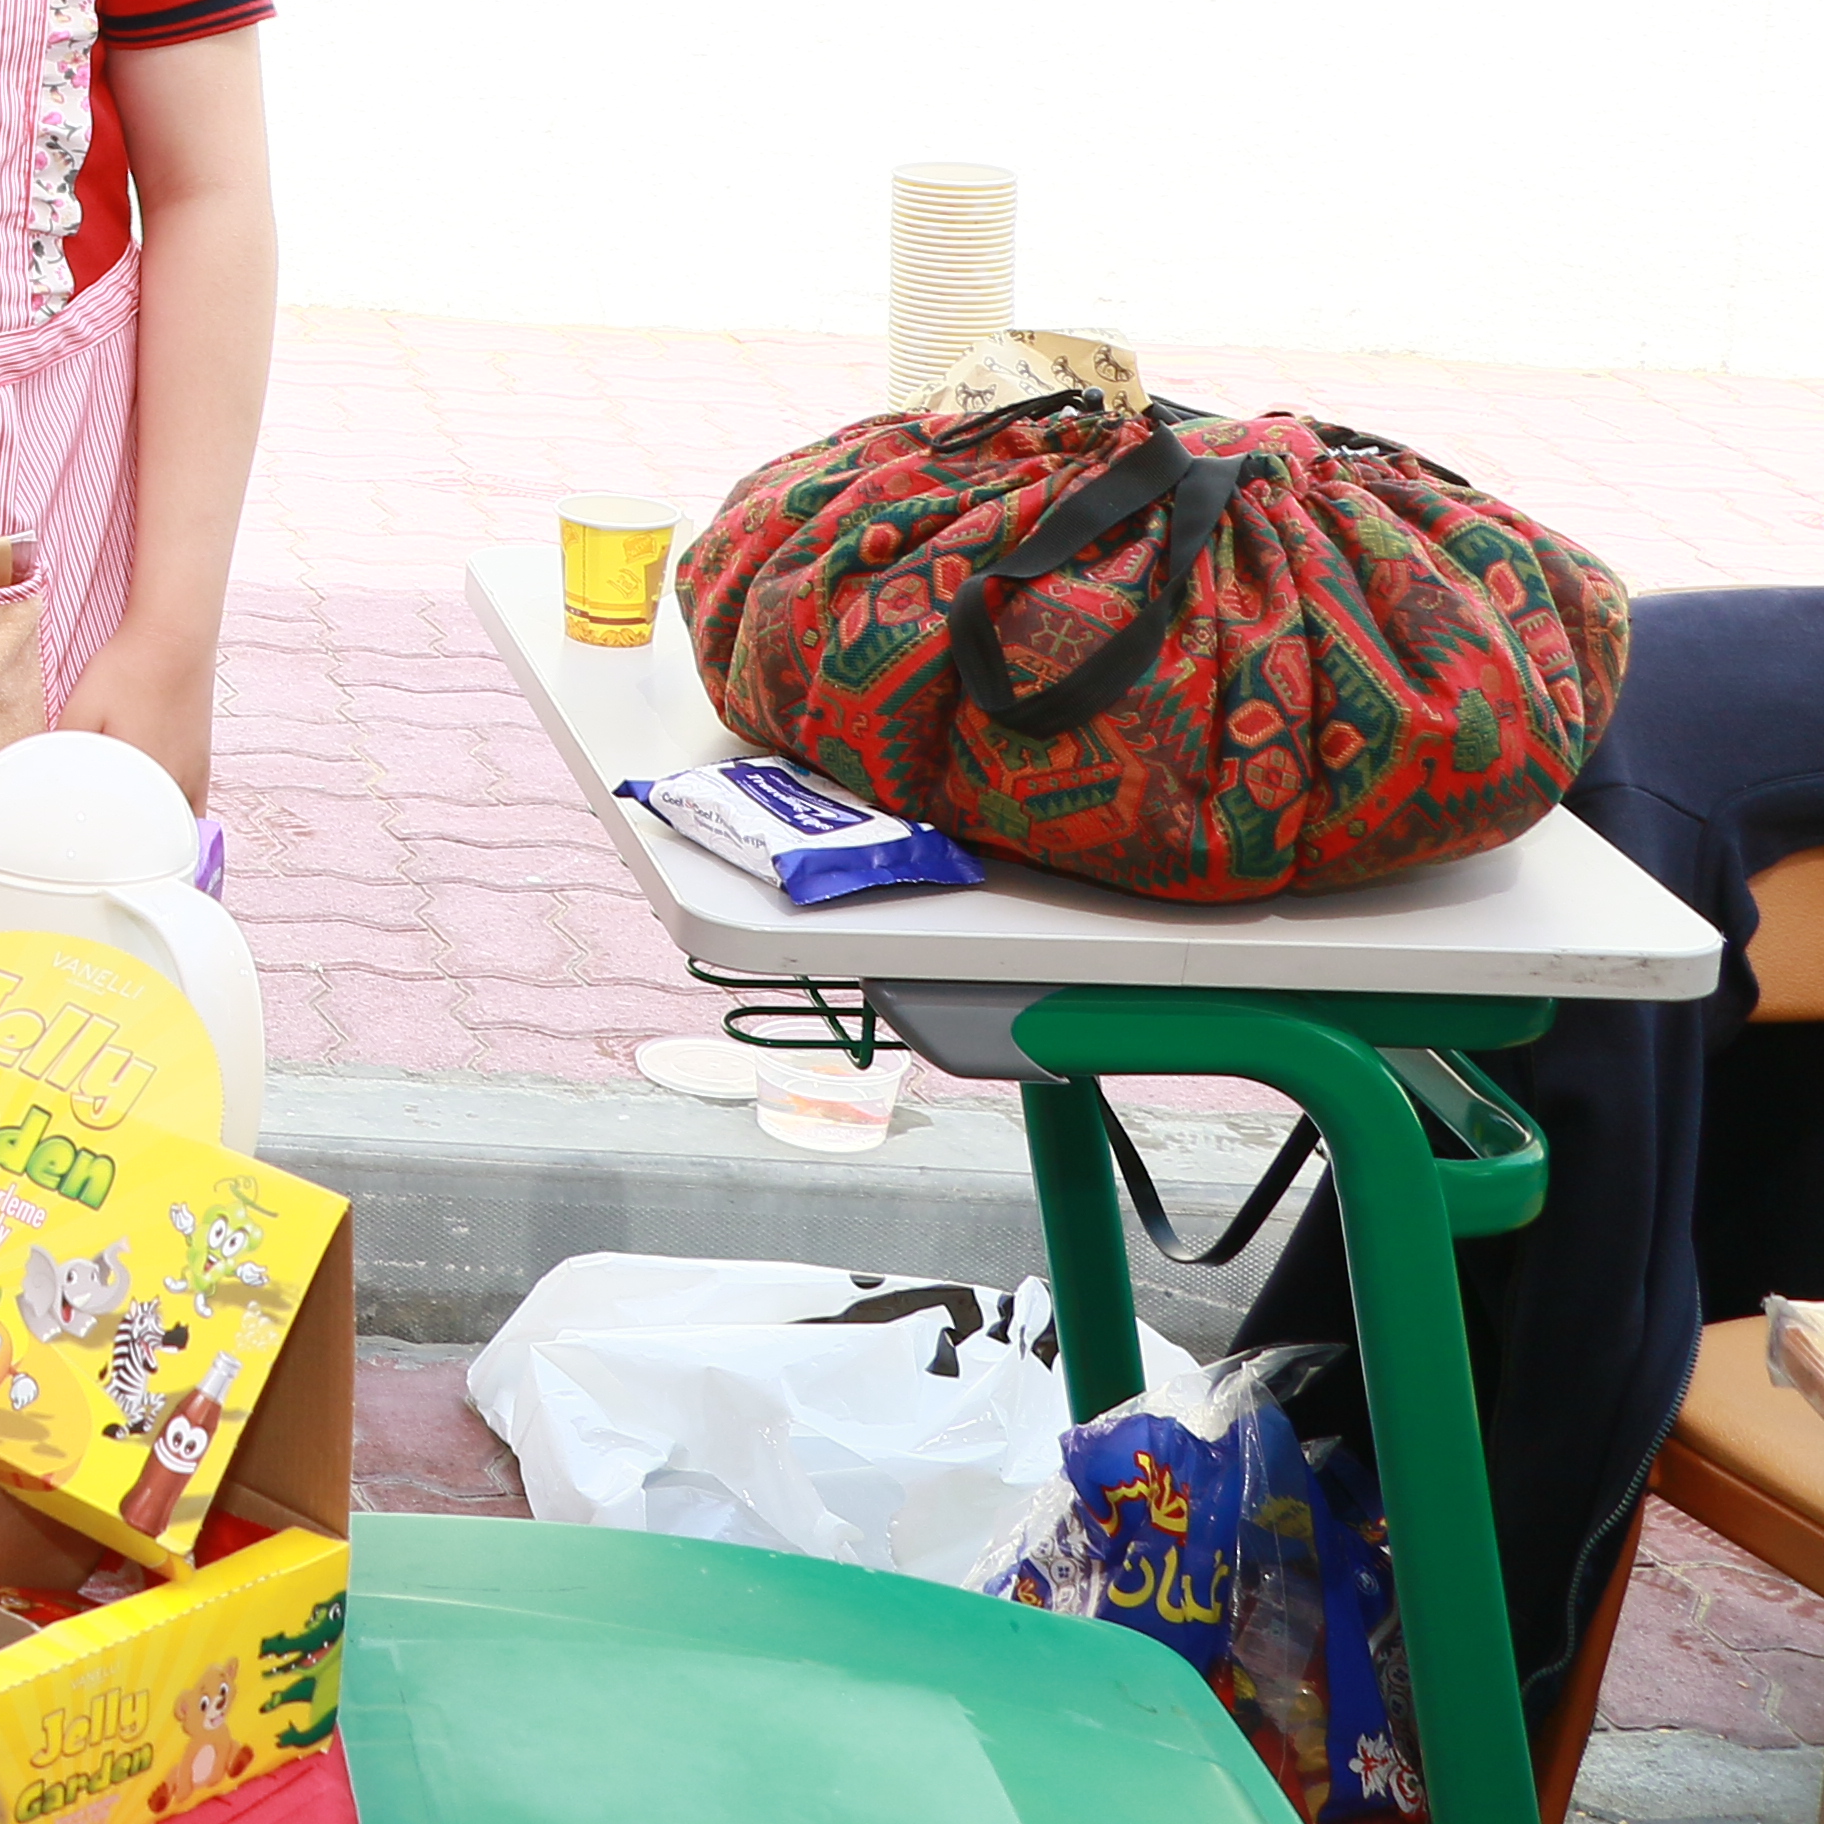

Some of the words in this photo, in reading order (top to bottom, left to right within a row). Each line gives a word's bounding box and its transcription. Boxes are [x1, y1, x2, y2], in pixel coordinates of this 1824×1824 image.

[52, 950, 145, 1000] VANELLI
[29, 1686, 150, 1769] Jelly
[14, 1742, 154, 1824] Garden
